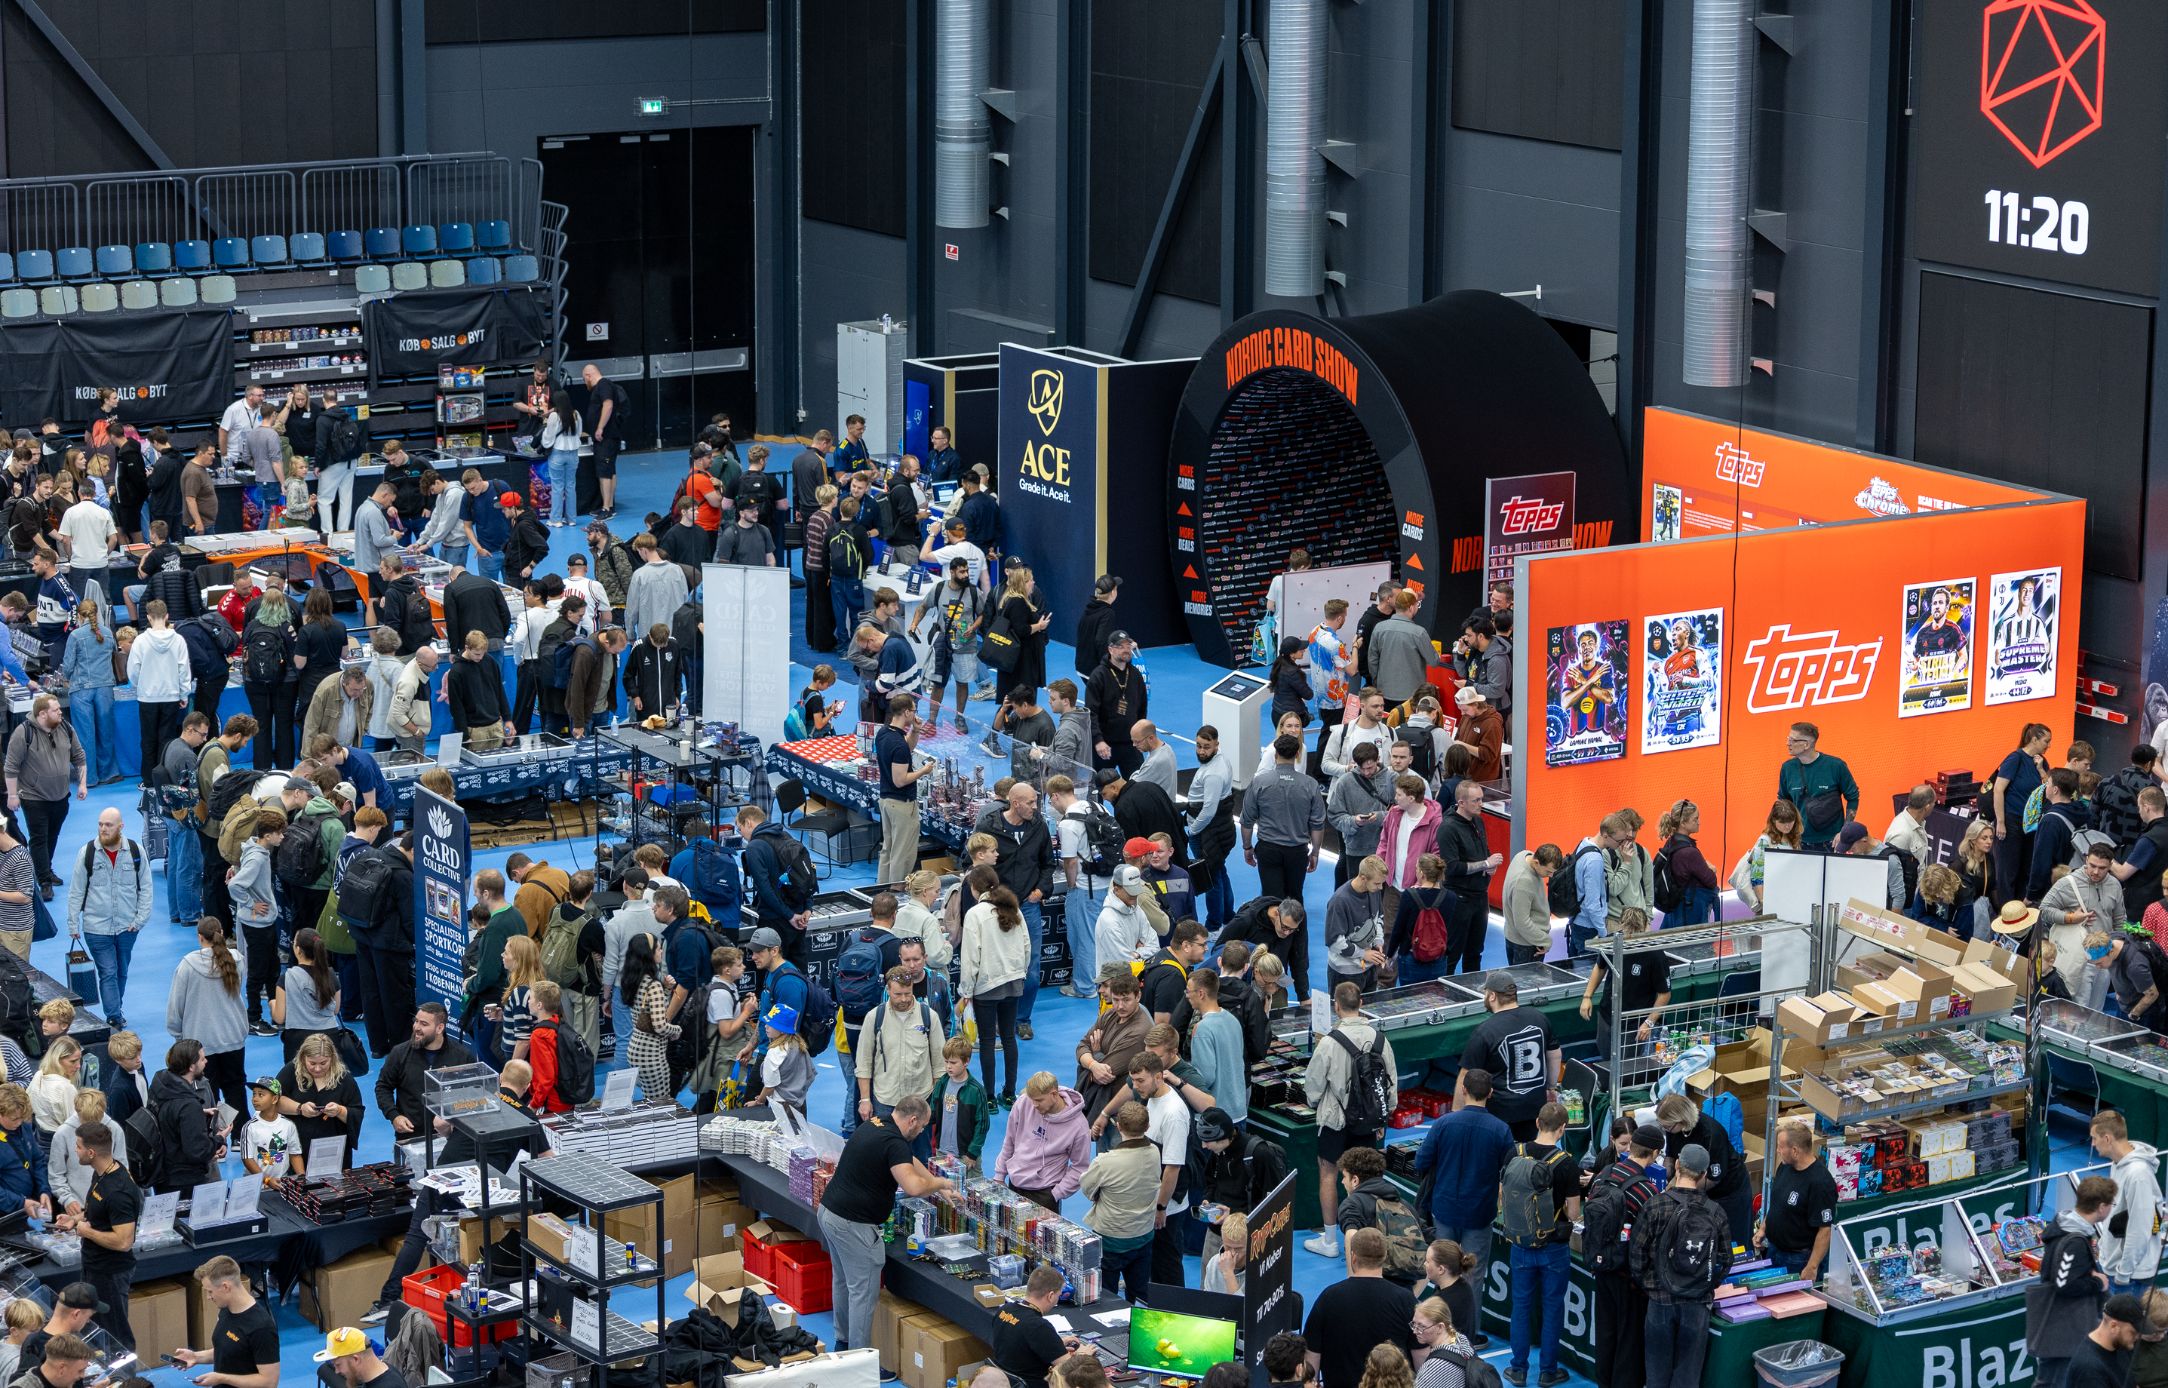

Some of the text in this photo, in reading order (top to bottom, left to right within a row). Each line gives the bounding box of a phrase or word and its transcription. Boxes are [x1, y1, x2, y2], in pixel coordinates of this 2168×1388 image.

[1985, 189, 2089, 255] 11:20
[399, 328, 485, 352] KØB SALG BYT
[1226, 327, 1358, 406] NORDIC CARD SHOW
[149, 384, 167, 399] BYT
[1020, 440, 1071, 487] ACE
[1179, 464, 1194, 478] MORE
[1019, 478, 1071, 503] Grade it. Ace it.
[1177, 477, 1195, 491] CARDS
[1857, 490, 1908, 514] Chrome
[1405, 510, 1425, 527] MORE
[1179, 526, 1194, 540] MORE
[1402, 522, 1424, 541] CARDS
[1178, 538, 1194, 552] DEALS
[1184, 601, 1213, 617] MEMORIES
[1191, 590, 1207, 604] MORE
[1999, 645, 2046, 659] SUPREME
[422, 834, 460, 870] CARD
[423, 856, 461, 883] COLLECTIVE
[424, 917, 462, 940] SPECIALISTER
[425, 929, 465, 957] SPORTKORT
[429, 972, 465, 996] KØBENHAV
[1514, 1041, 1541, 1080] B
[1864, 1202, 2016, 1257] Blaes
[1923, 1338, 2036, 1388] Blaz
